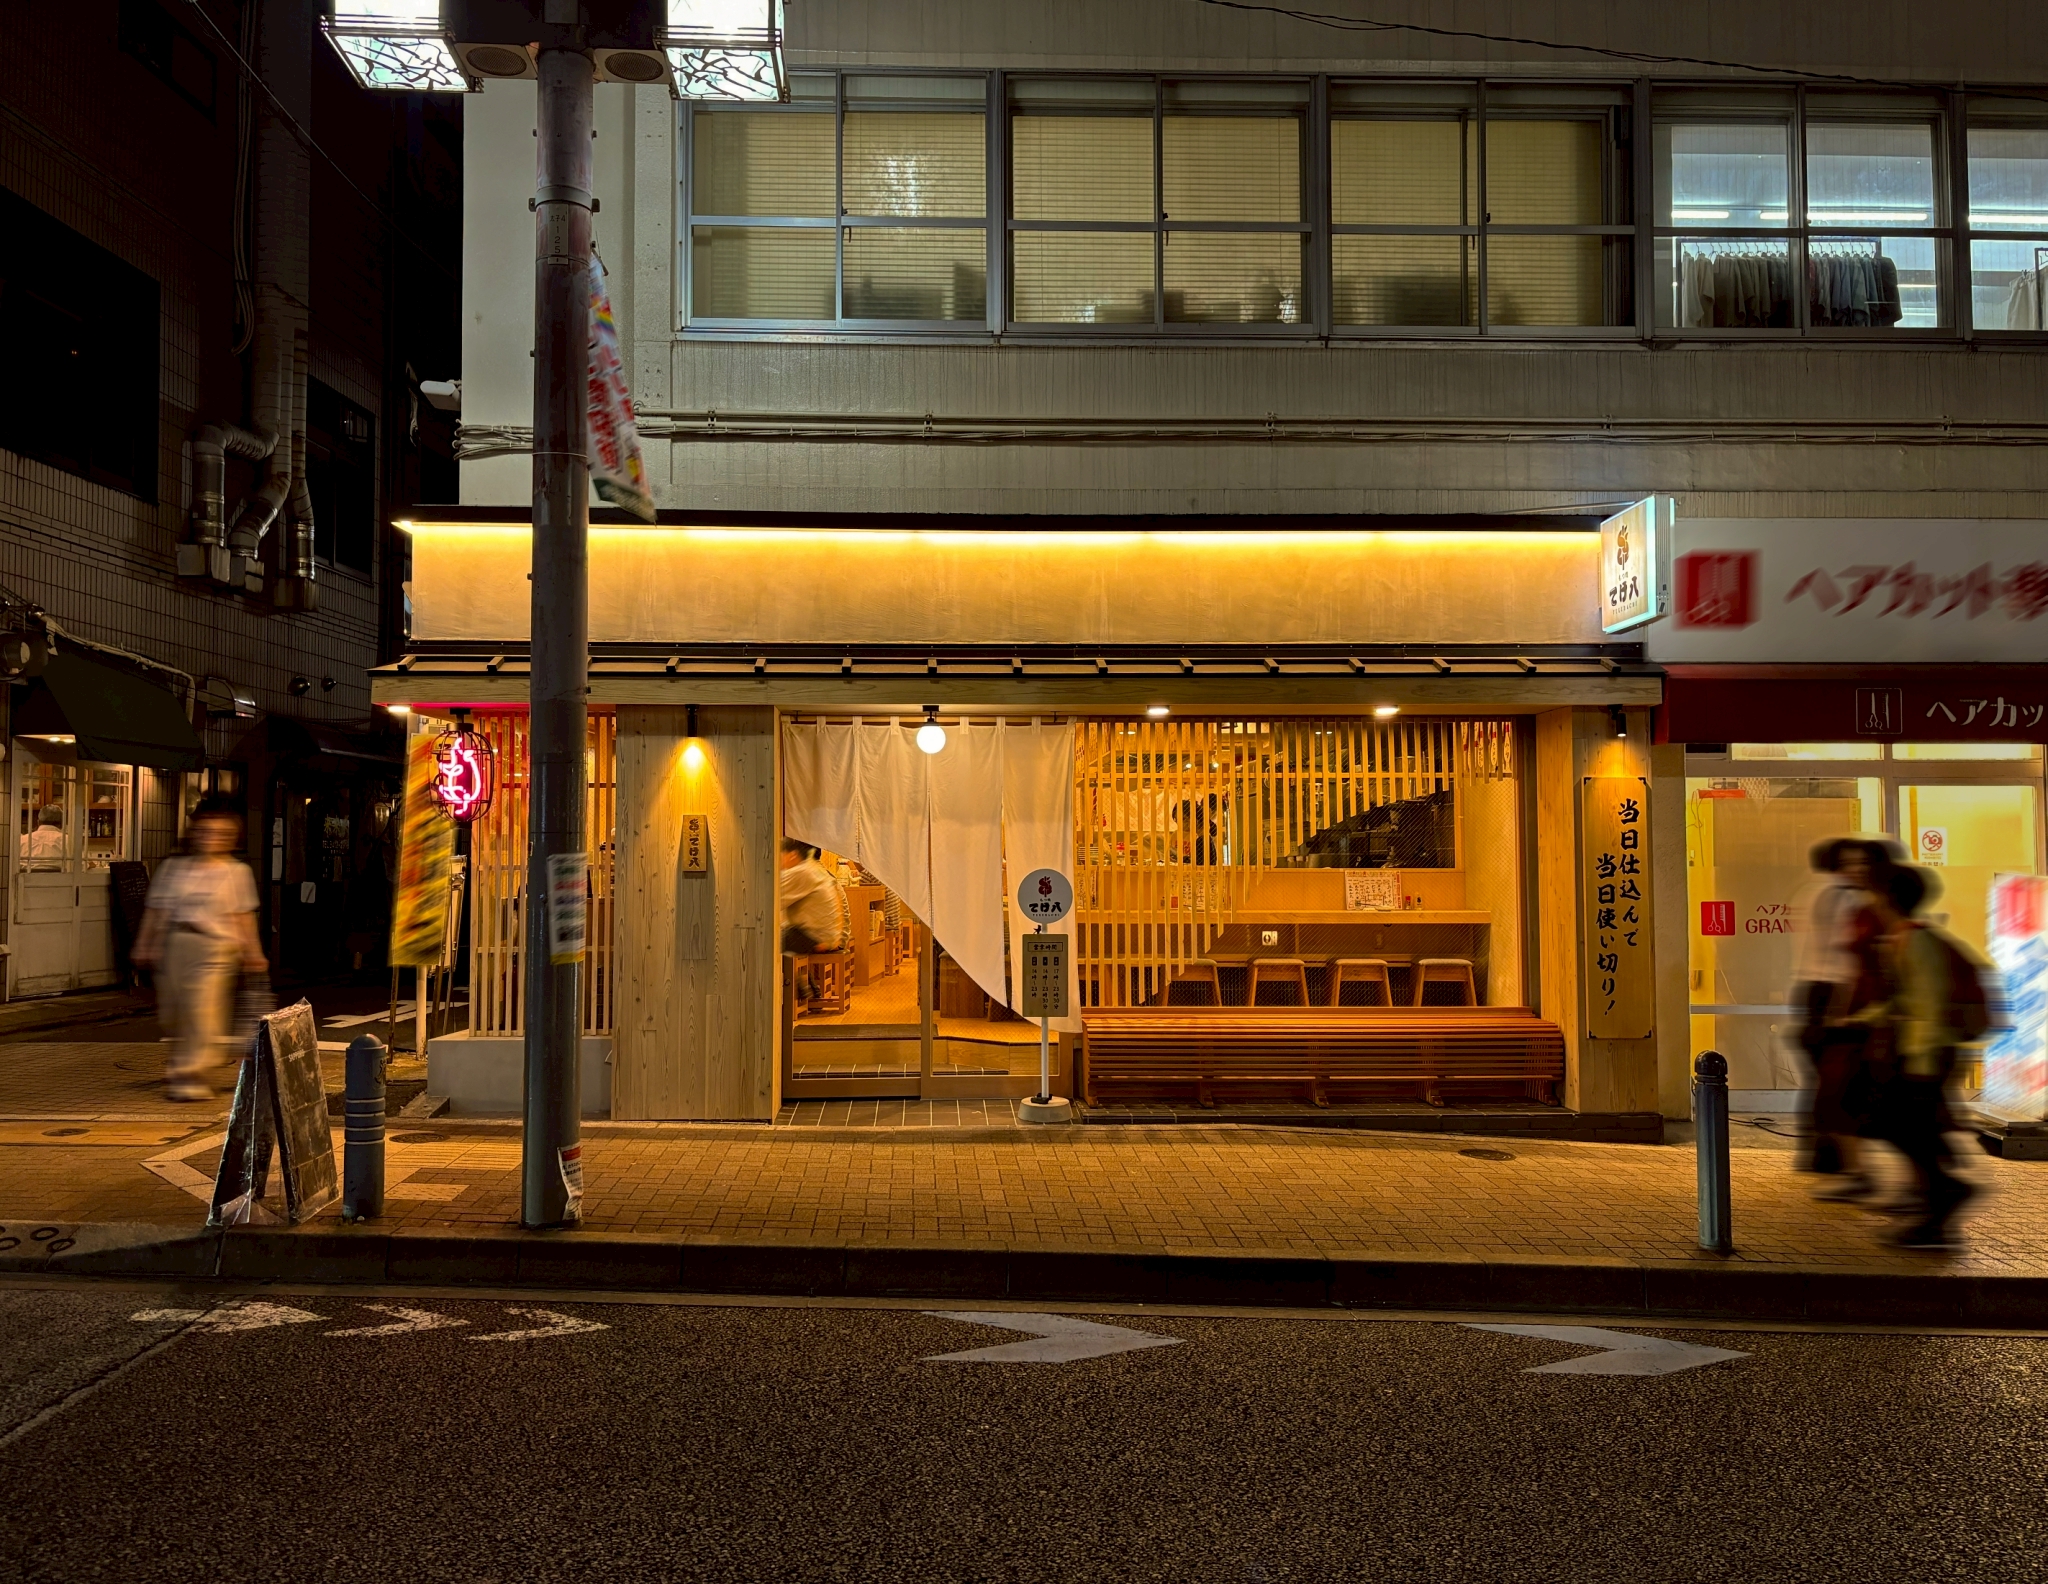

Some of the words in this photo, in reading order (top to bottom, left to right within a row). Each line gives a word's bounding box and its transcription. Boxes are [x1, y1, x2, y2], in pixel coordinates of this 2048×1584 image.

[1618, 797, 1642, 947] 当日仕込んで
